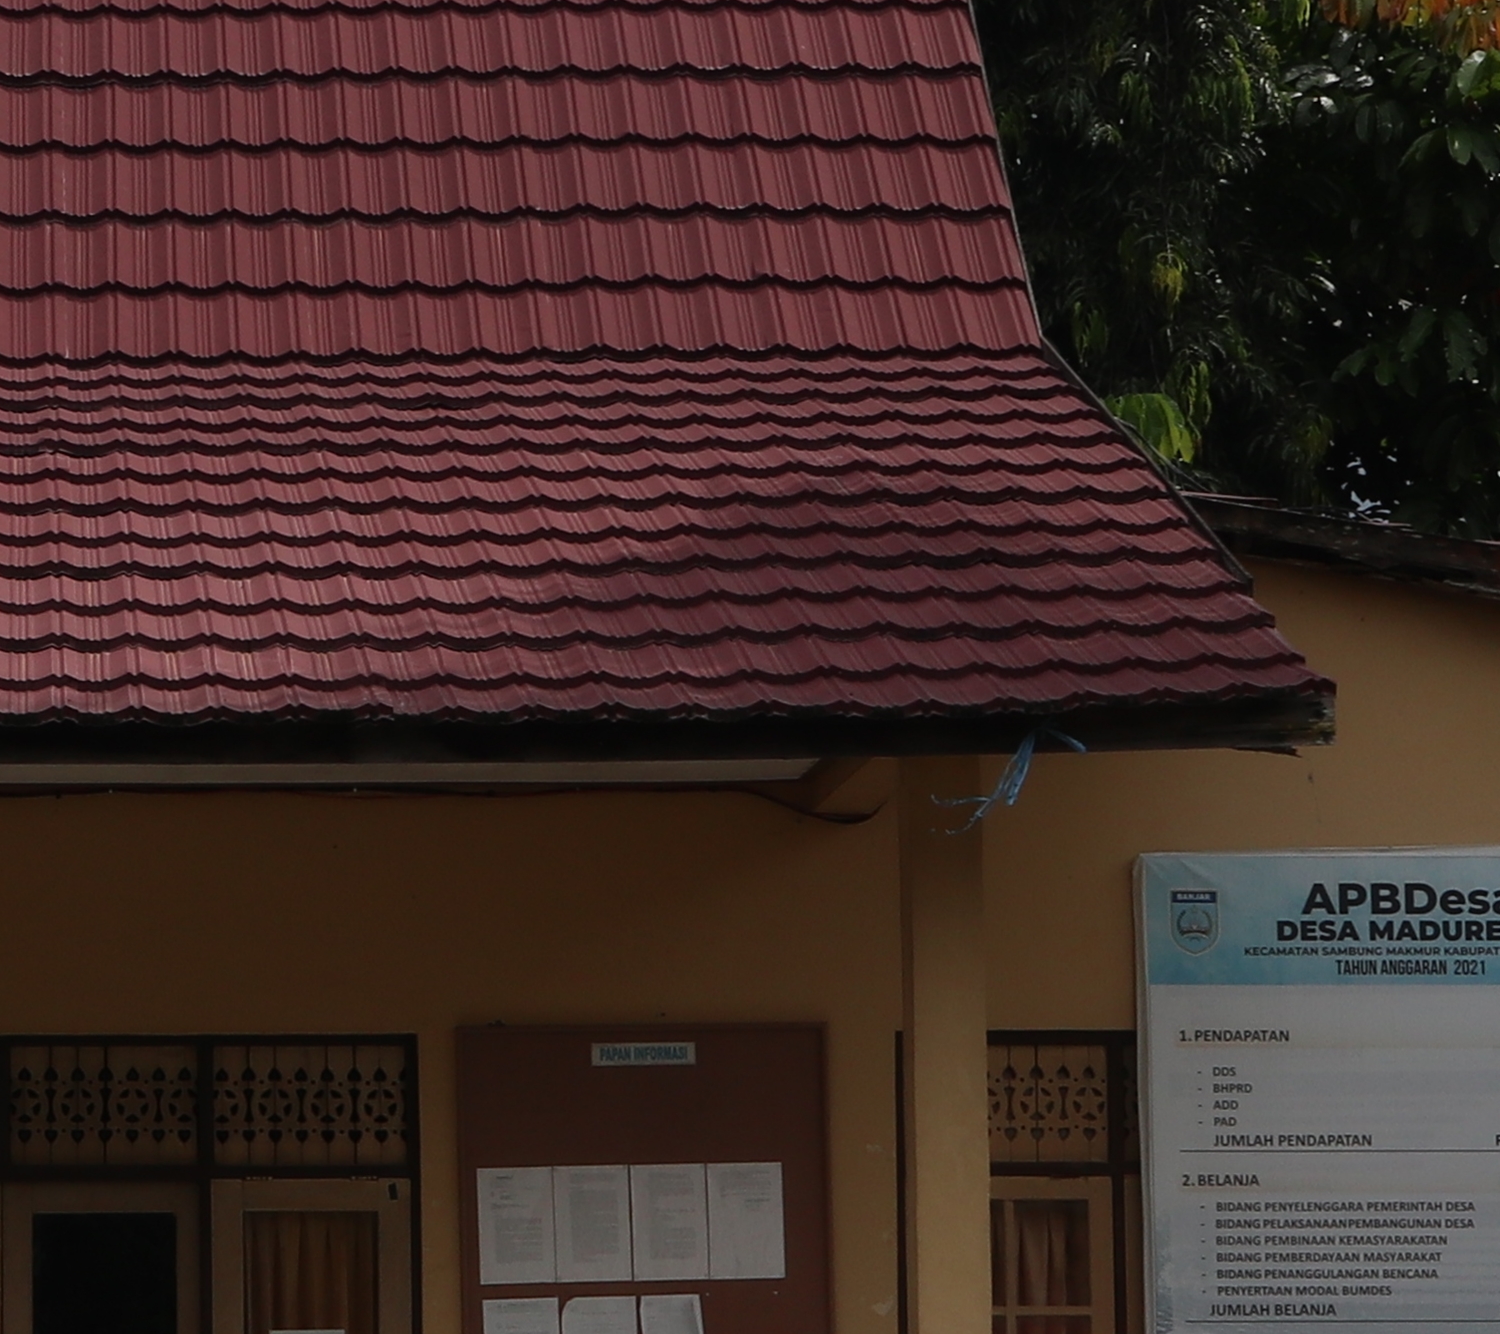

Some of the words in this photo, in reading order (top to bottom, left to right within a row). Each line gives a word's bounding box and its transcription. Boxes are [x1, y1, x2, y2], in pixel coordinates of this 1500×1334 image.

[1276, 921, 1365, 941] DESA
[1244, 946, 1319, 957] KECAMATAN
[1322, 946, 1383, 957] SAMBUNG
[1386, 946, 1440, 957] MAKMUR
[1336, 961, 1378, 976] TAHUN
[1380, 961, 1447, 976] ANGGARAN
[1454, 961, 1486, 976] 2021
[1195, 1029, 1289, 1042] PENDAPATAN
[600, 1047, 631, 1061] PAPAN
[634, 1046, 688, 1061] INFORMASI
[1213, 1066, 1236, 1077] DDS
[1213, 1083, 1253, 1094] BHPRD
[1213, 1100, 1239, 1111] ADD
[1214, 1117, 1237, 1127] PAD
[1214, 1134, 1273, 1148] JUMLAH
[1278, 1134, 1372, 1148] PENDAPATAN
[1198, 1174, 1260, 1187] BELANJA
[1216, 1202, 1262, 1212] BIDANG
[1264, 1202, 1364, 1212] PENYELENGGARA
[1366, 1202, 1442, 1212] PEMERINTAH
[1446, 1202, 1475, 1212] DESA
[1216, 1252, 1262, 1263] BIDANG
[1264, 1252, 1360, 1263] PEMBERDAYAAN
[1363, 1252, 1441, 1263] MASYARAKAT
[1210, 1303, 1271, 1316] JUMLAH
[1274, 1303, 1337, 1316] BELANJA
